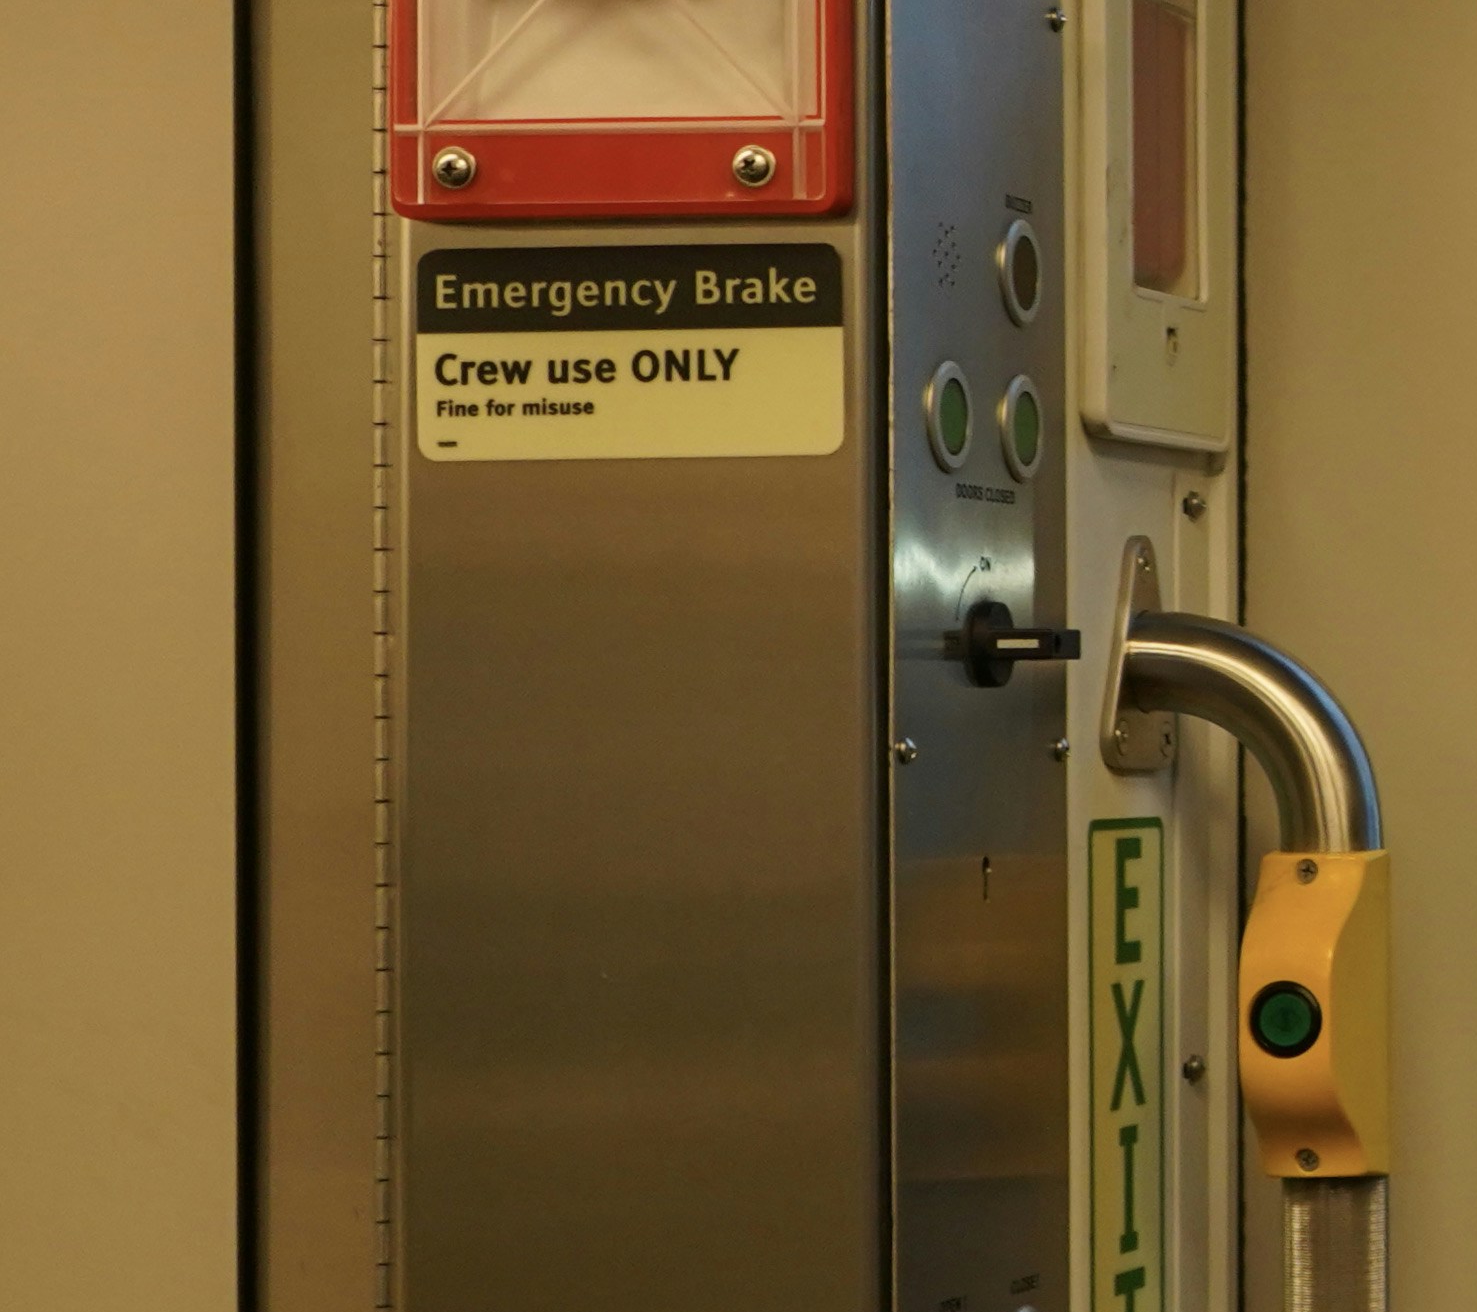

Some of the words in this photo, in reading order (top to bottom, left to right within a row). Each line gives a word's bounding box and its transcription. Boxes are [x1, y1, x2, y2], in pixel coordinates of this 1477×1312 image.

[435, 273, 677, 316] Emergency
[694, 267, 817, 305] Brake
[434, 353, 532, 387] Crew
[547, 357, 616, 384] use
[631, 348, 740, 382] ONLY
[436, 400, 479, 418] Fine
[485, 398, 516, 417] for
[522, 398, 595, 416] misuse
